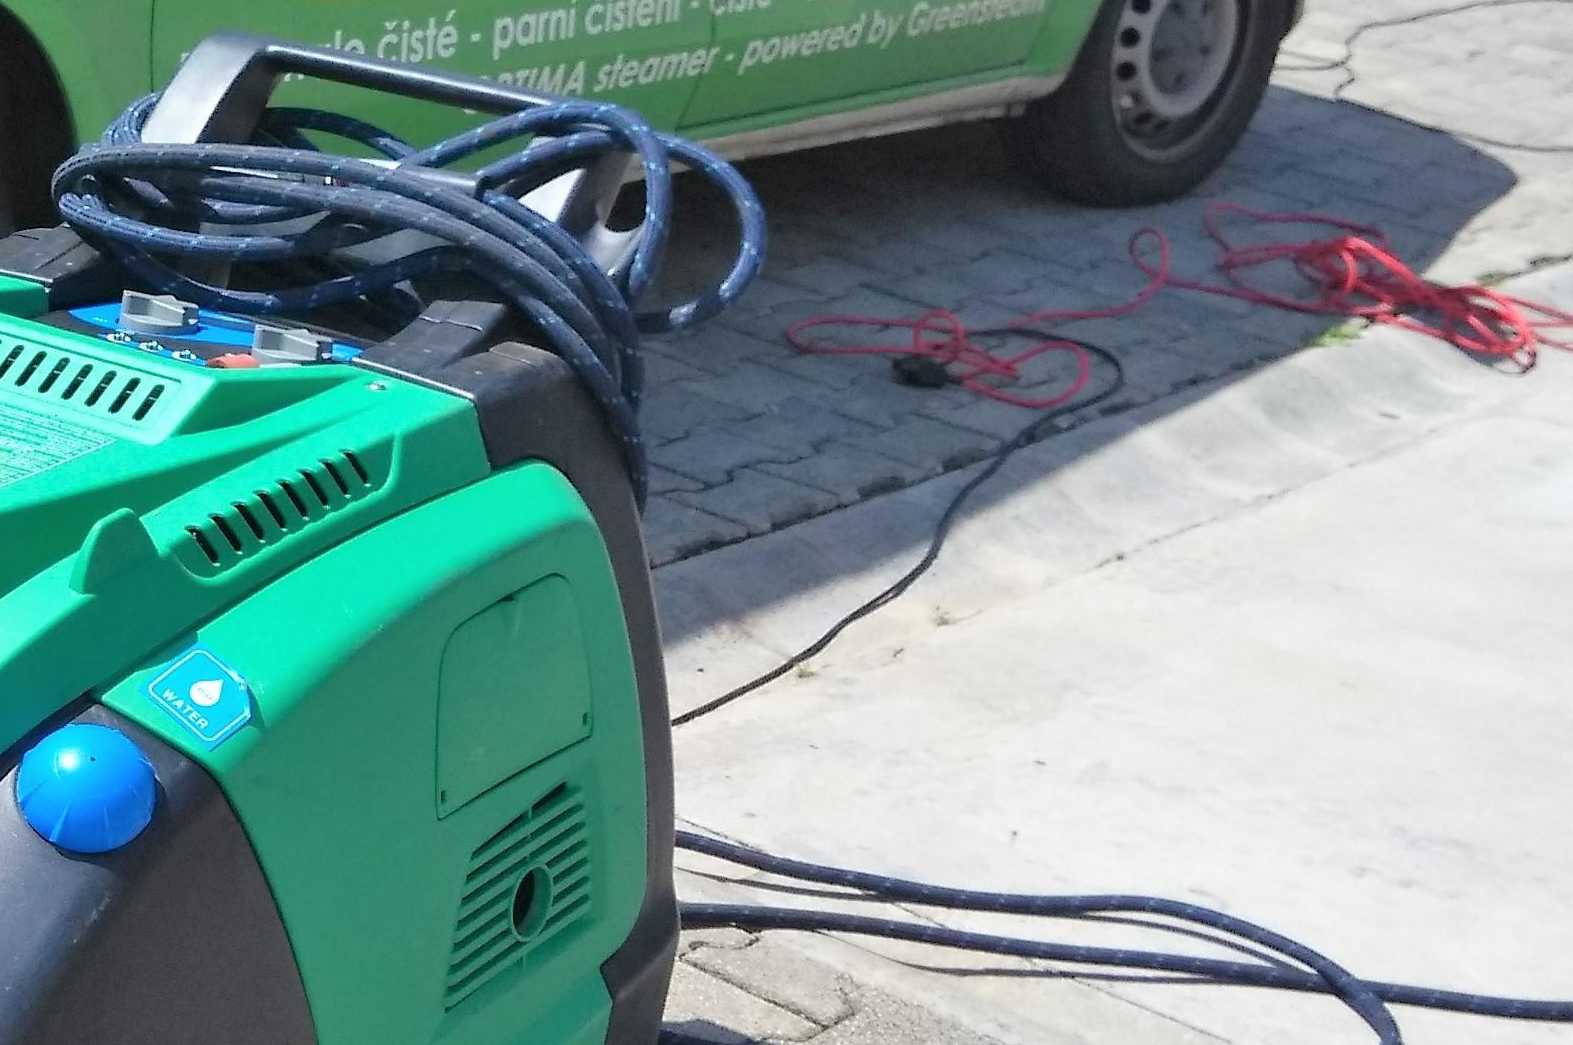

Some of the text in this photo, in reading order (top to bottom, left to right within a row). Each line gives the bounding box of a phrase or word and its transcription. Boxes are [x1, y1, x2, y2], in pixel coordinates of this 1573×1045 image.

[377, 9, 458, 63] čisté
[593, 46, 711, 94] steamer
[737, 12, 867, 77] powered
[867, 9, 905, 50] by
[162, 688, 209, 729] WATER
